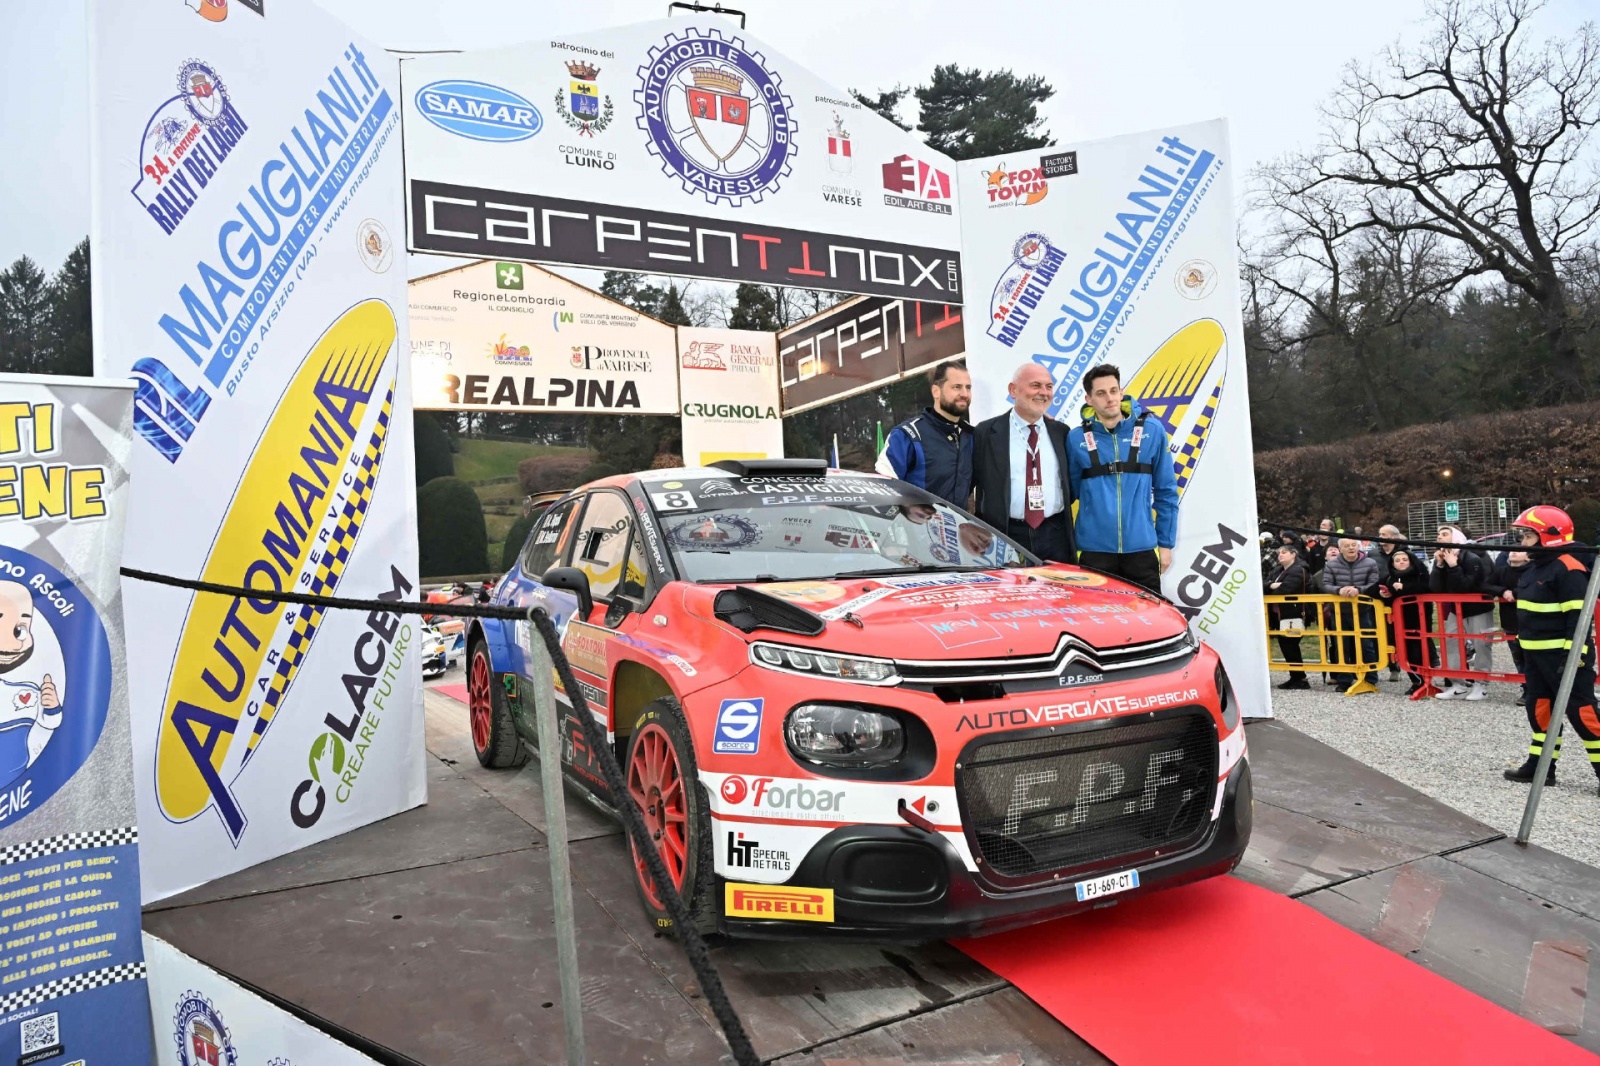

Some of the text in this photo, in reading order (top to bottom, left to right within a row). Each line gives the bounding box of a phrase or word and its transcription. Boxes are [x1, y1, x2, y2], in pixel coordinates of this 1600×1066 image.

[551, 41, 615, 59] patrocinio del
[647, 41, 740, 123] AUTOMOBILE
[425, 93, 533, 127] SAMAR
[763, 83, 788, 144] CLUB
[815, 95, 862, 110] patrocinio del
[144, 155, 169, 186] 34
[173, 123, 202, 160] EDIZIONE
[559, 145, 617, 160] COMUNE DI
[565, 155, 615, 170] LUINO
[1045, 156, 1073, 167] FACTORY
[147, 102, 249, 236] RALLY DEI LAGHI
[682, 161, 764, 195] VARESE
[1008, 166, 1047, 186] FOX
[1045, 165, 1074, 175] STORES
[823, 193, 862, 207] VARESE
[987, 181, 1047, 202] TOWN
[158, 42, 380, 367] MAGUGLIANI.it
[885, 196, 905, 207] EDIL
[907, 200, 926, 210] ART
[220, 240, 299, 360] COMPONENTI
[297, 204, 321, 237] PER
[319, 113, 381, 203] L'INDUSTRIA
[226, 342, 262, 398] Busto
[258, 281, 295, 342] Arsizio
[295, 244, 319, 281] (VA)
[323, 110, 400, 234] www.magugliani.it
[1032, 136, 1198, 385] AGUGLIANI.it
[1094, 337, 1115, 367] sizio
[1115, 304, 1135, 334] (VA)
[1140, 159, 1224, 292] www.magugliani.it
[453, 289, 566, 306] RegioneLombardia
[994, 305, 1010, 322] 34
[1012, 272, 1031, 301] EDIZIONE
[996, 306, 1030, 348] RALLY
[1019, 283, 1045, 311] DEI
[1032, 245, 1067, 287] LAGHI
[1052, 309, 1116, 407] COMPONENTI
[1116, 276, 1136, 304] PER
[1134, 175, 1198, 271] L'INDUSTRIA
[496, 305, 534, 314] CONSIGLIO
[730, 344, 761, 356] BANCA
[730, 355, 775, 367] GENERALI
[603, 360, 653, 373] VARESE
[441, 374, 641, 408] REALPINA
[683, 403, 778, 420] CRUGNOLA
[664, 492, 689, 508] 8
[747, 484, 892, 496] CASTIGLIONI
[246, 450, 361, 717] CAR & SERVICE
[1173, 522, 1248, 623] ACEM
[29, 573, 75, 617] Ascoli
[170, 338, 388, 840] AUTOMANIA
[1197, 569, 1247, 635] FUTURO
[1004, 614, 1153, 631] VARESE
[335, 623, 412, 804] CREARE FUTURO
[721, 741, 750, 750] sparco
[751, 778, 846, 812] Forbar
[753, 849, 790, 861] SPECIAL
[753, 859, 790, 871] METALS
[43, 880, 62, 891] PER
[1086, 873, 1130, 896] FJ-669-CT
[733, 889, 825, 916] PIRELLI
[31, 946, 55, 959] VITA
[178, 1000, 212, 1057] AUTOMOBILE
[22, 1048, 60, 1065] INSTAGRAM
